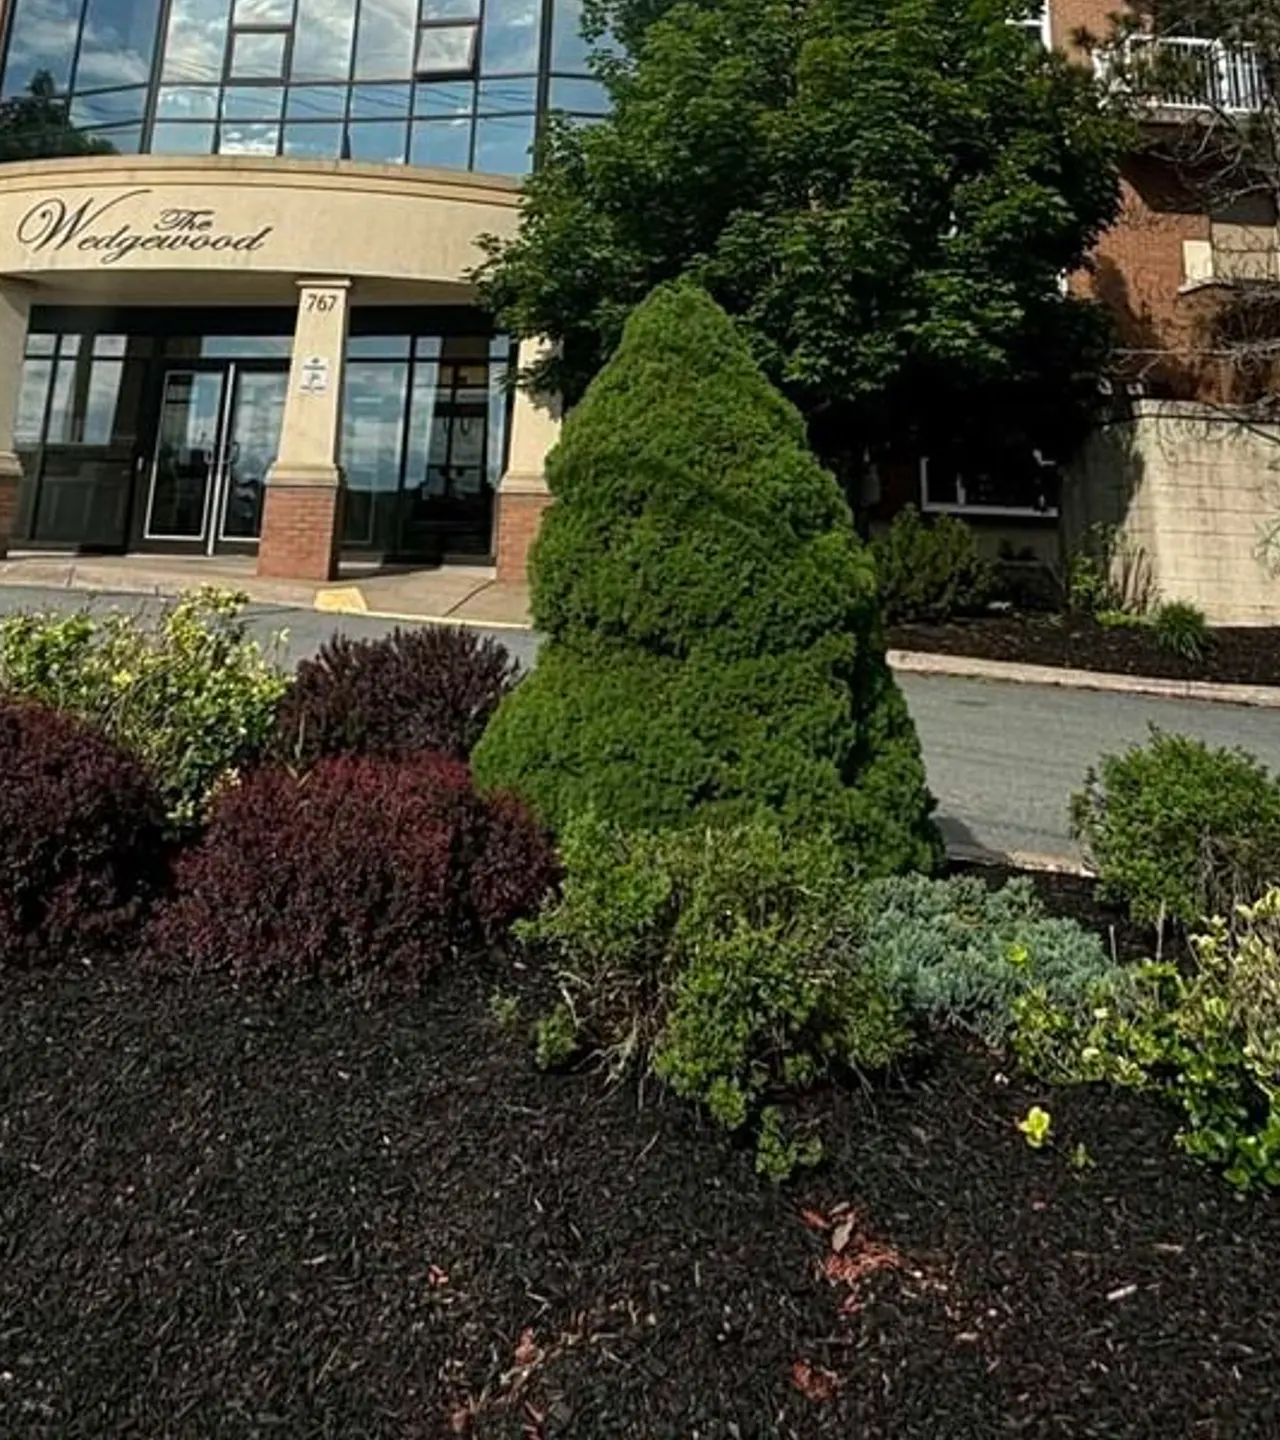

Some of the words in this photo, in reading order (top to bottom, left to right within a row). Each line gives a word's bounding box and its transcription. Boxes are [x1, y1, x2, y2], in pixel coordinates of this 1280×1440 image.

[16, 189, 274, 265] Wedgewood
[153, 208, 214, 232] The
[306, 293, 338, 313] 767
